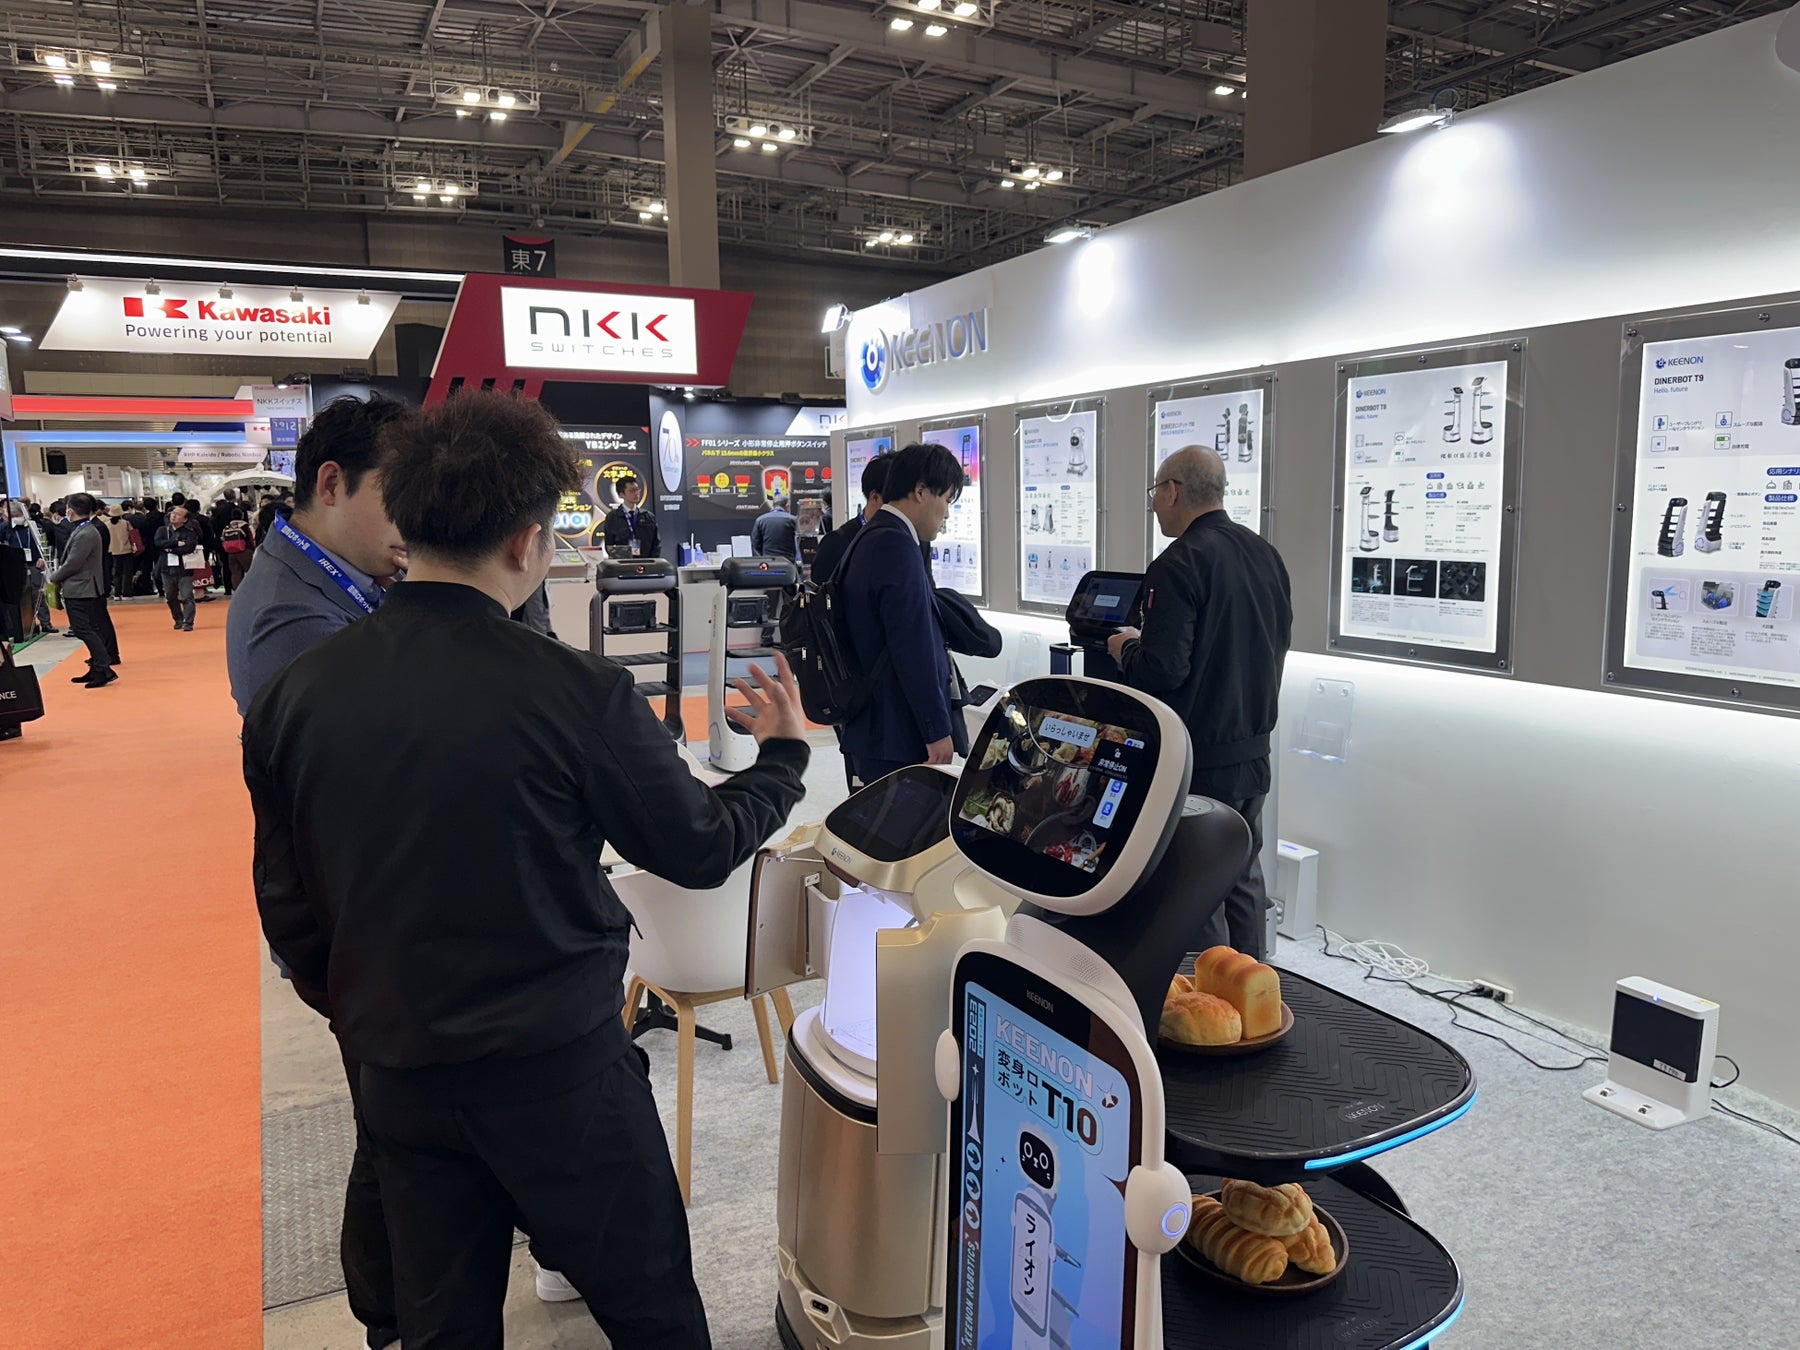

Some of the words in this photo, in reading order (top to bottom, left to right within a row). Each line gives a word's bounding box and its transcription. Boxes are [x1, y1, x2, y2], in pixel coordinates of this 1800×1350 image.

[511, 249, 548, 272] 東7
[198, 300, 331, 326] Kawasaki
[125, 324, 208, 341] Powering
[214, 329, 252, 342] your
[259, 331, 332, 343] potential
[890, 308, 987, 372] KEENON
[531, 342, 673, 358] SWITCHES
[1668, 356, 1704, 366] KEENON
[1654, 375, 1692, 385] DINERBOT
[1363, 389, 1386, 397] KEENON
[1355, 404, 1379, 412] DINERBOT
[1045, 723, 1091, 742] いらっしゃいませ
[1026, 989, 1054, 1013] KEENON
[968, 998, 978, 1053] 2023
[995, 1014, 1094, 1100] KEENON
[997, 1048, 1039, 1088] 変身ロ
[997, 1070, 1038, 1107] ボット
[1042, 1080, 1098, 1147] T10
[1345, 1103, 1385, 1120] KEENON
[1024, 1213, 1036, 1296] ライオン
[965, 1240, 977, 1298] ROBOTICS
[963, 1299, 976, 1346] KEENON
